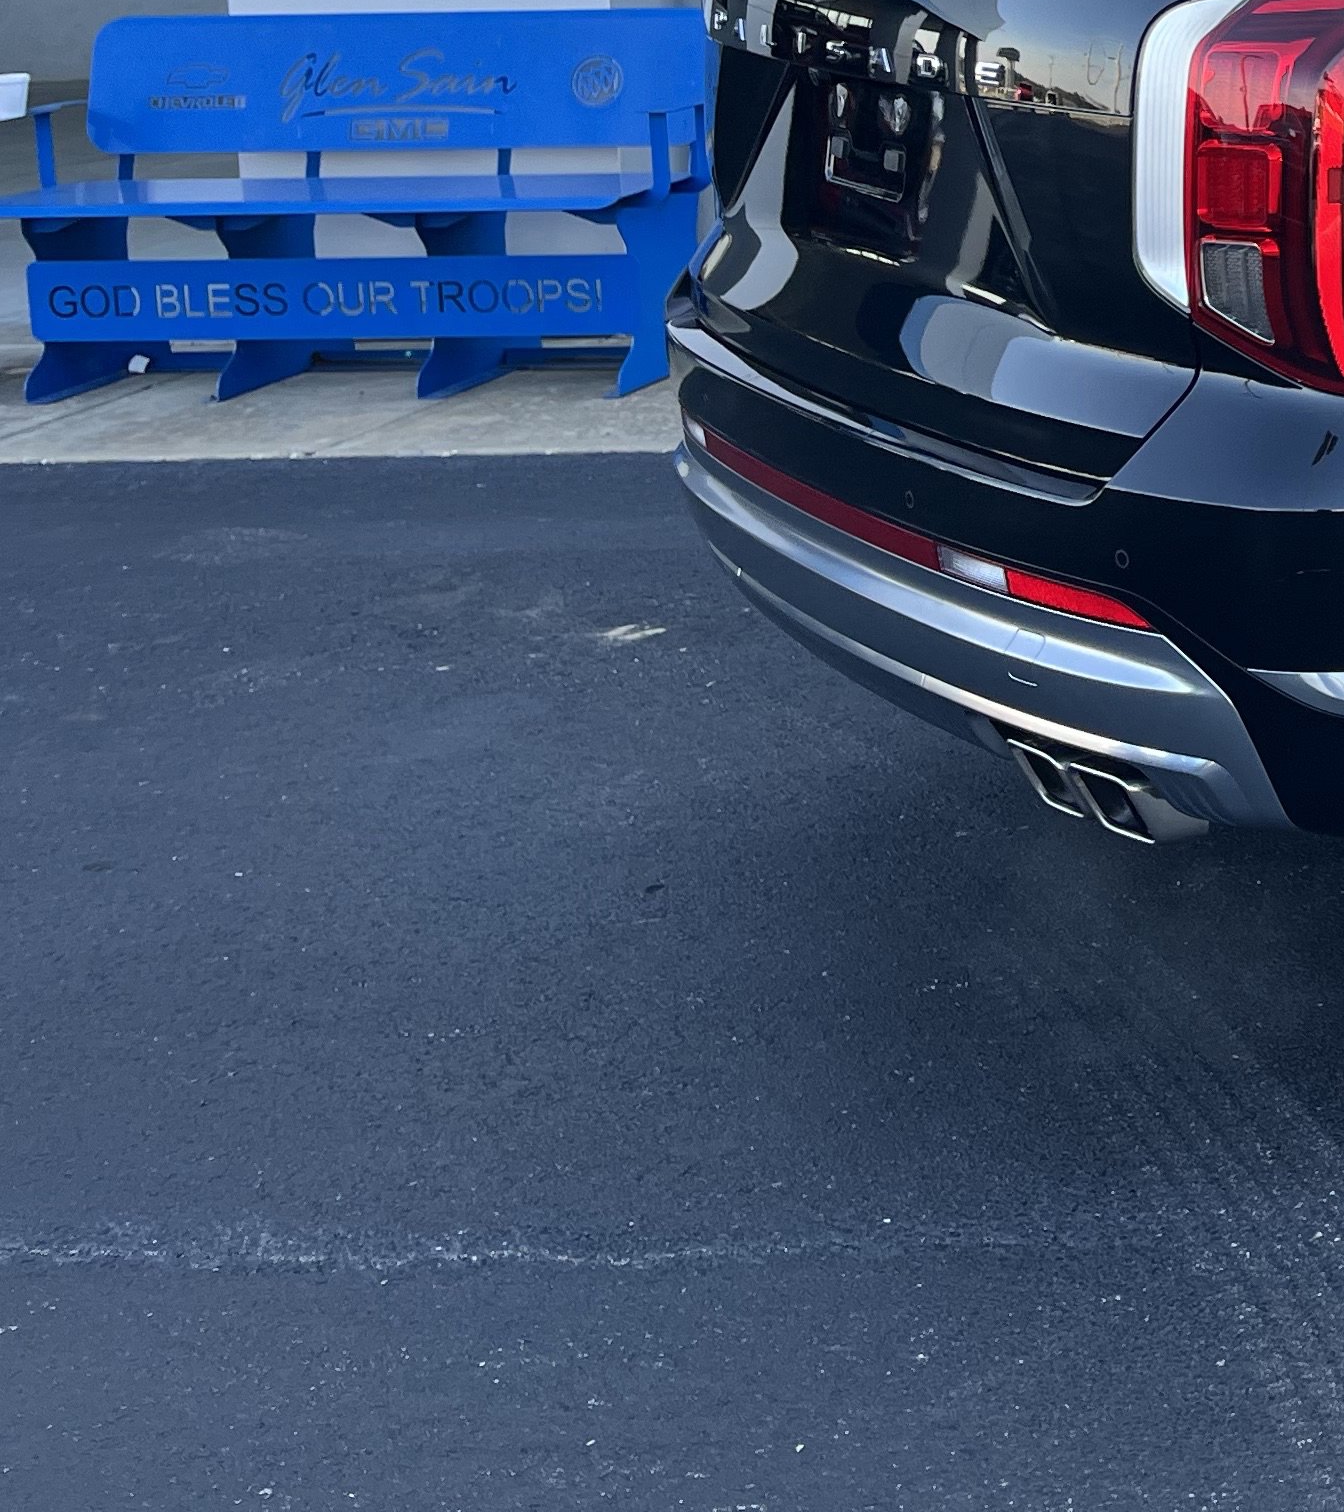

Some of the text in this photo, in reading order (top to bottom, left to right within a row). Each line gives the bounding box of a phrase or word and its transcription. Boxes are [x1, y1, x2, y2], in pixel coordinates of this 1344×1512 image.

[48, 277, 603, 319] GOD BLESS OUR TROOPS!
